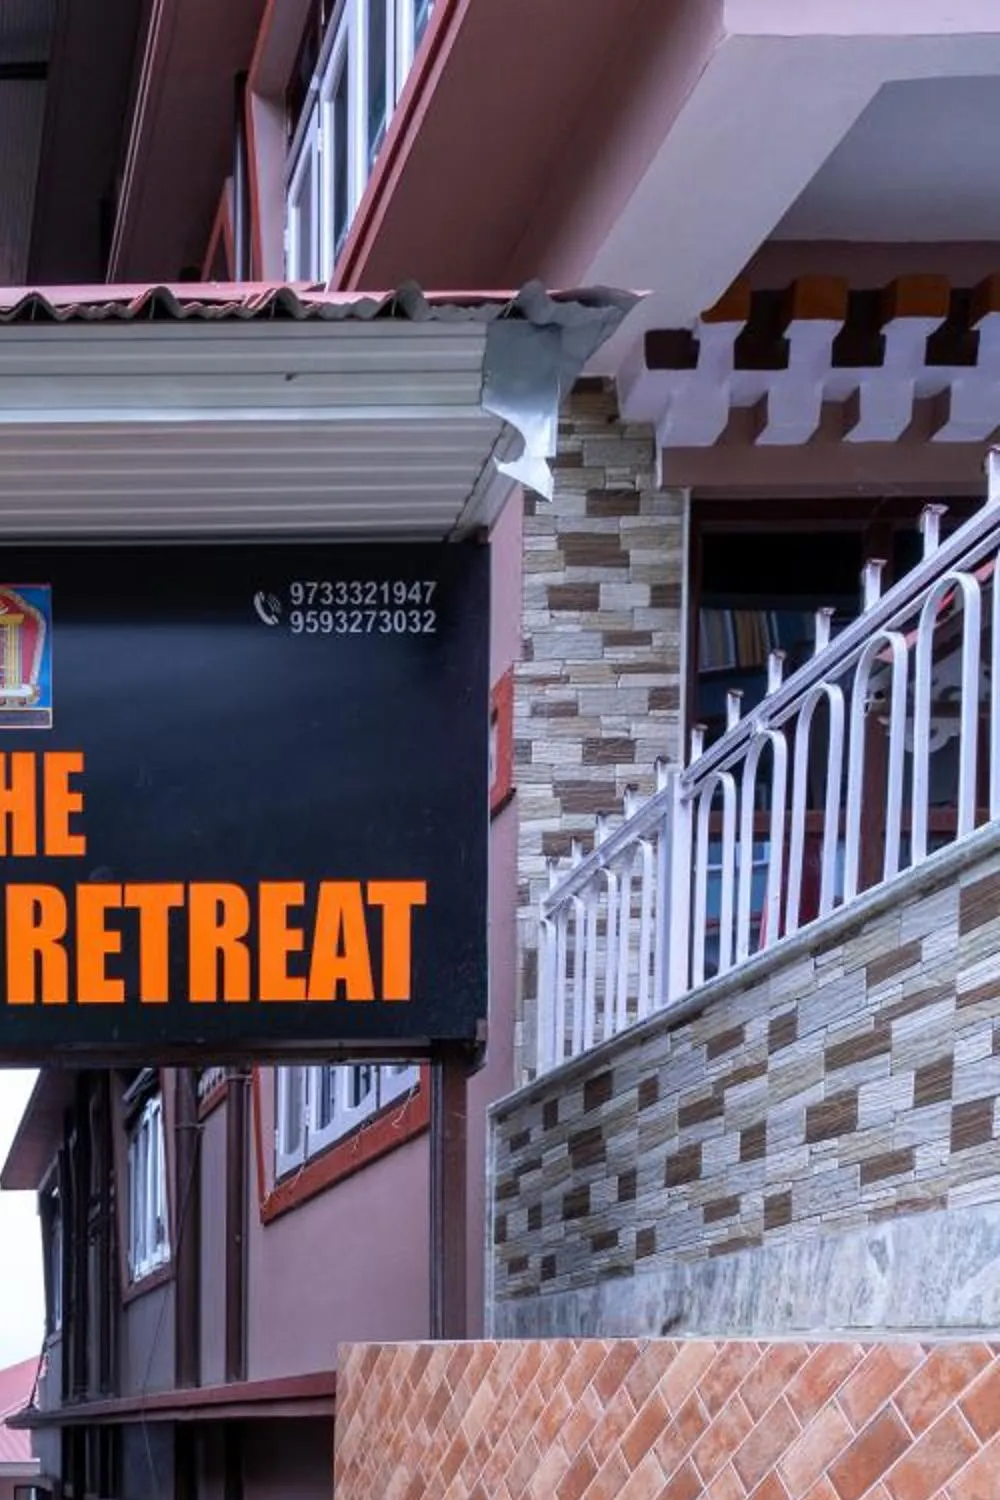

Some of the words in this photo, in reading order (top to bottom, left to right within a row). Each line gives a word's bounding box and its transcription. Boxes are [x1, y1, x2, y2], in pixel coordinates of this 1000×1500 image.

[290, 581, 436, 605] 9733321947
[289, 609, 436, 634] 9593273032
[5, 879, 428, 1005] RETREAT
